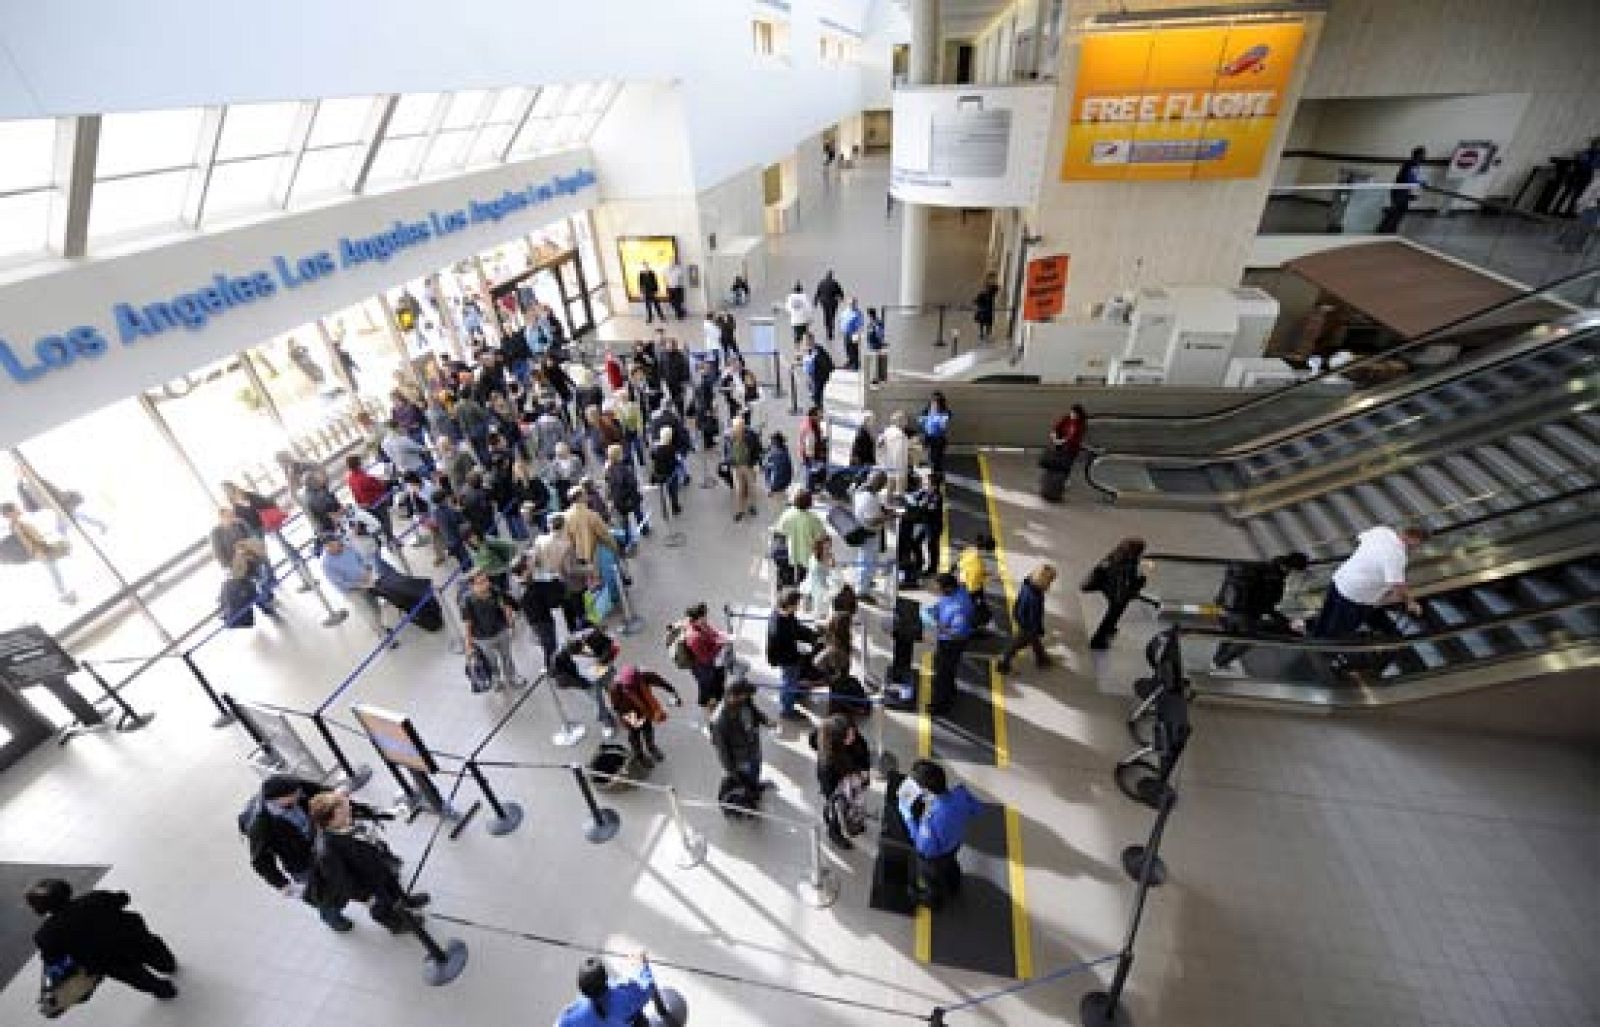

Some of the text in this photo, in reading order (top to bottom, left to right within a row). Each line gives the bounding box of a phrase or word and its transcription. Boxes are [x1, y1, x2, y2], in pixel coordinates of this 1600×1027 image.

[1081, 91, 1278, 122] FREE FLIGHT
[0, 325, 108, 384] Los
[113, 272, 277, 344] Angeles
[274, 253, 336, 288] Los
[339, 220, 431, 268] Angeles
[429, 211, 468, 236] Los
[468, 191, 527, 223] Angeles
